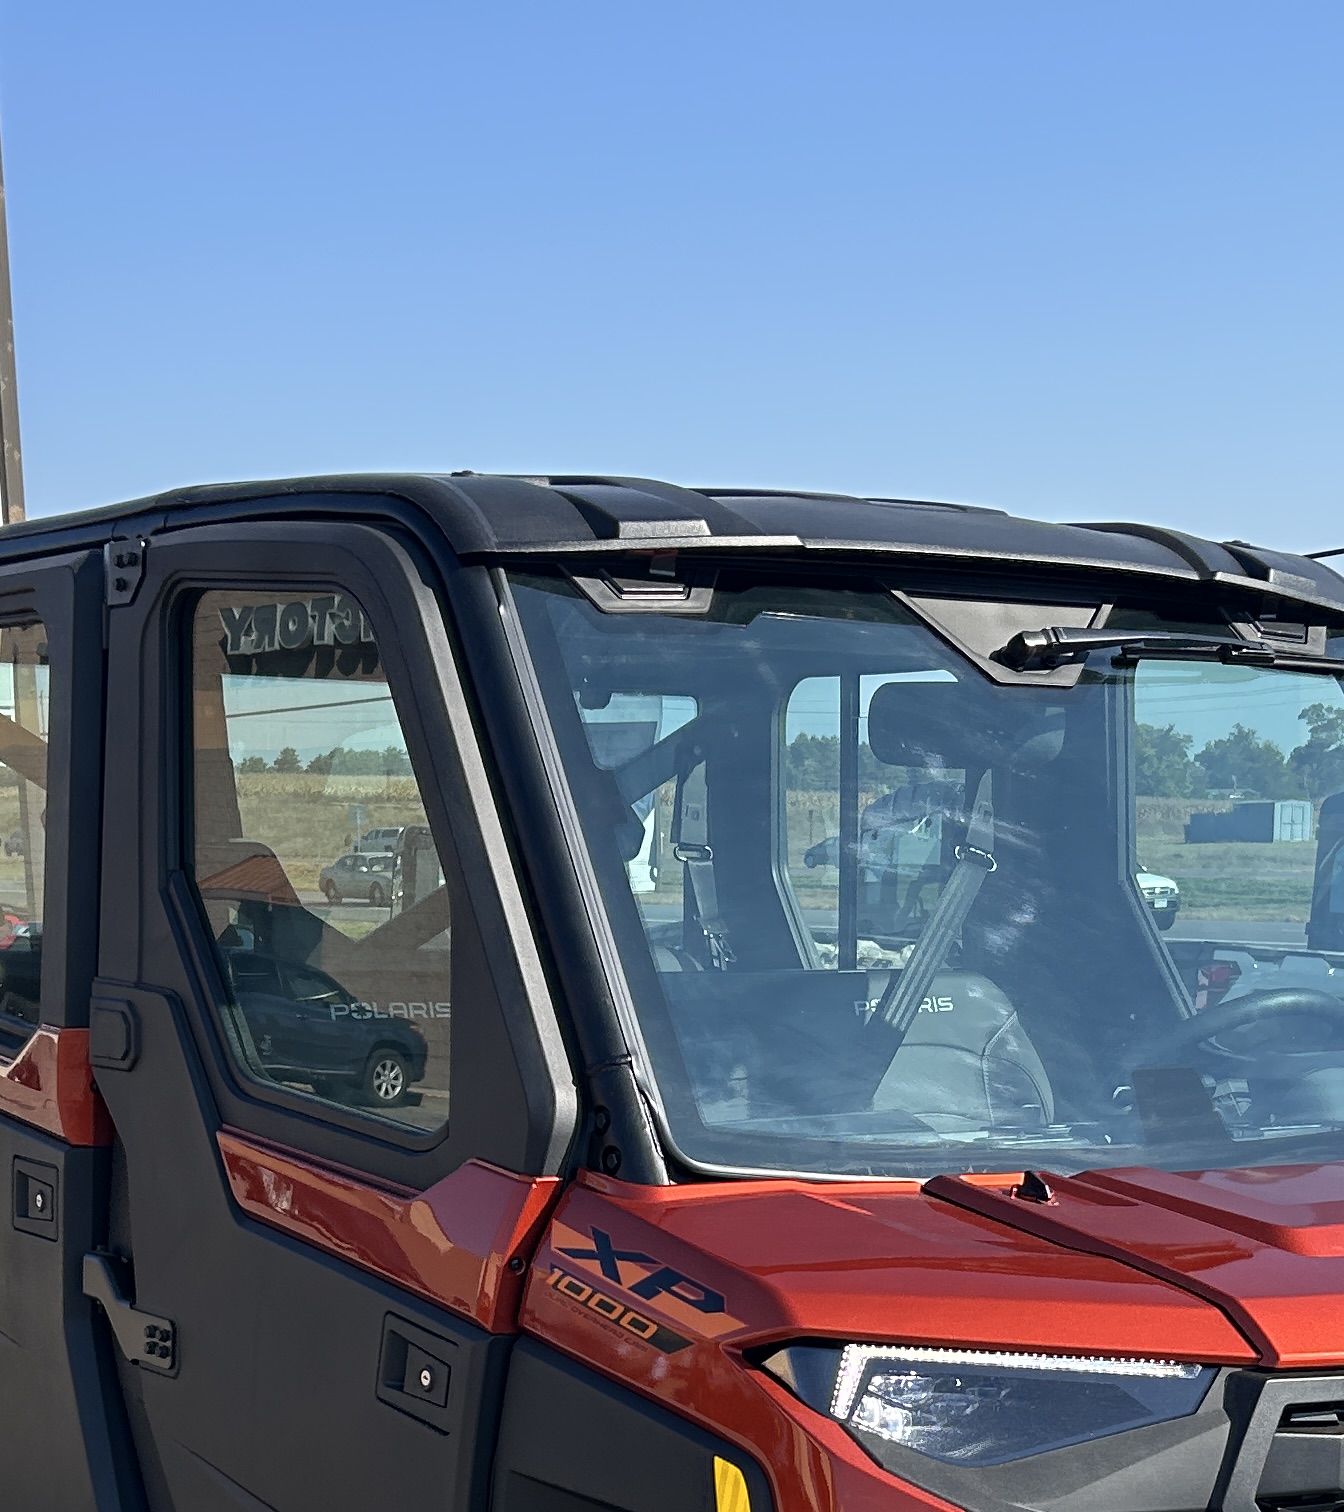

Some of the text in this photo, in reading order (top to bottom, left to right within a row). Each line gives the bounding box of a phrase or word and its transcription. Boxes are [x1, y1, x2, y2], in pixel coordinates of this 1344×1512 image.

[329, 1001, 451, 1020] POLARIS
[545, 1267, 659, 1339] 1000
[553, 1224, 727, 1314] XP
